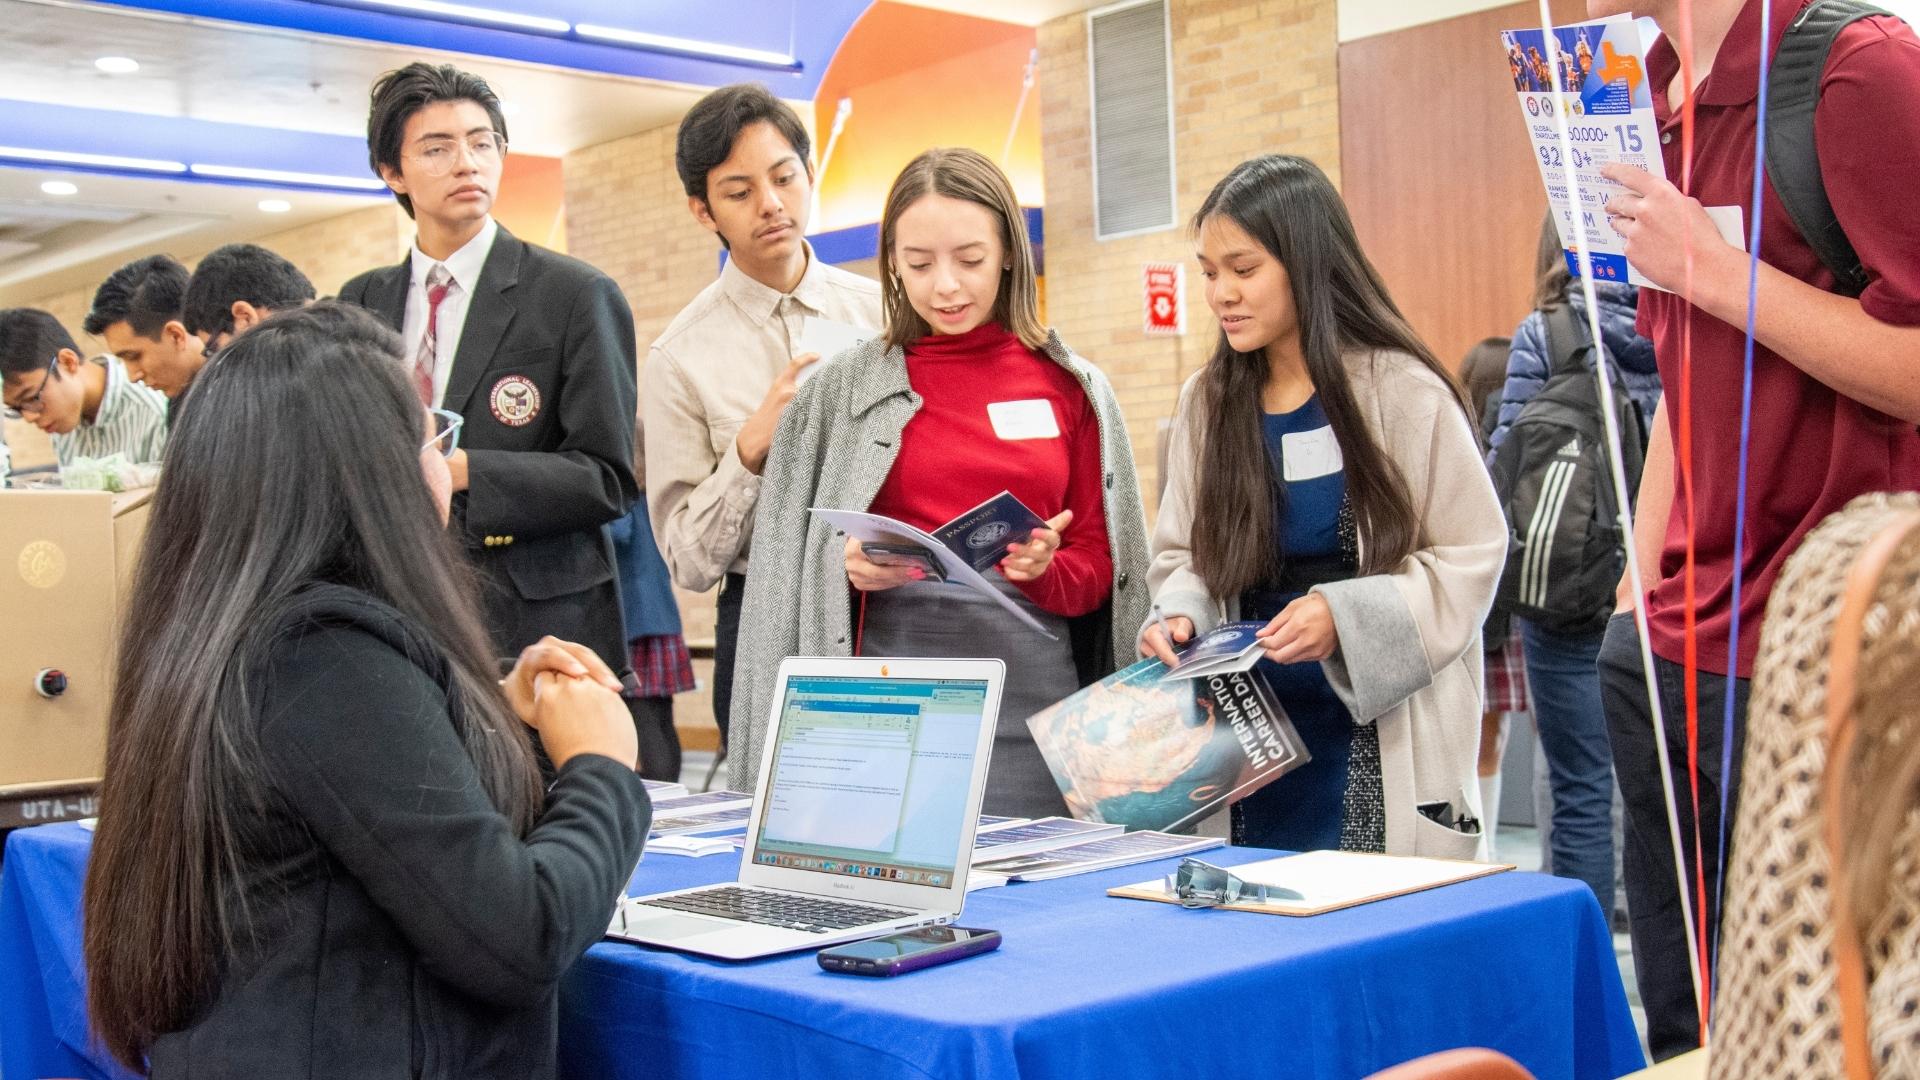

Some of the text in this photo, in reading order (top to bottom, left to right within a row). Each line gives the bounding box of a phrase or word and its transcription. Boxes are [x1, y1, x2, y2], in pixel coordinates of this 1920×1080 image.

[1533, 124, 1553, 132] GLOBAL
[1535, 132, 1560, 140] ENROLLME
[1614, 124, 1643, 152] 15
[946, 505, 998, 538] PASSPORT
[1227, 672, 1250, 697] DA
[1242, 695, 1284, 760] CAREER
